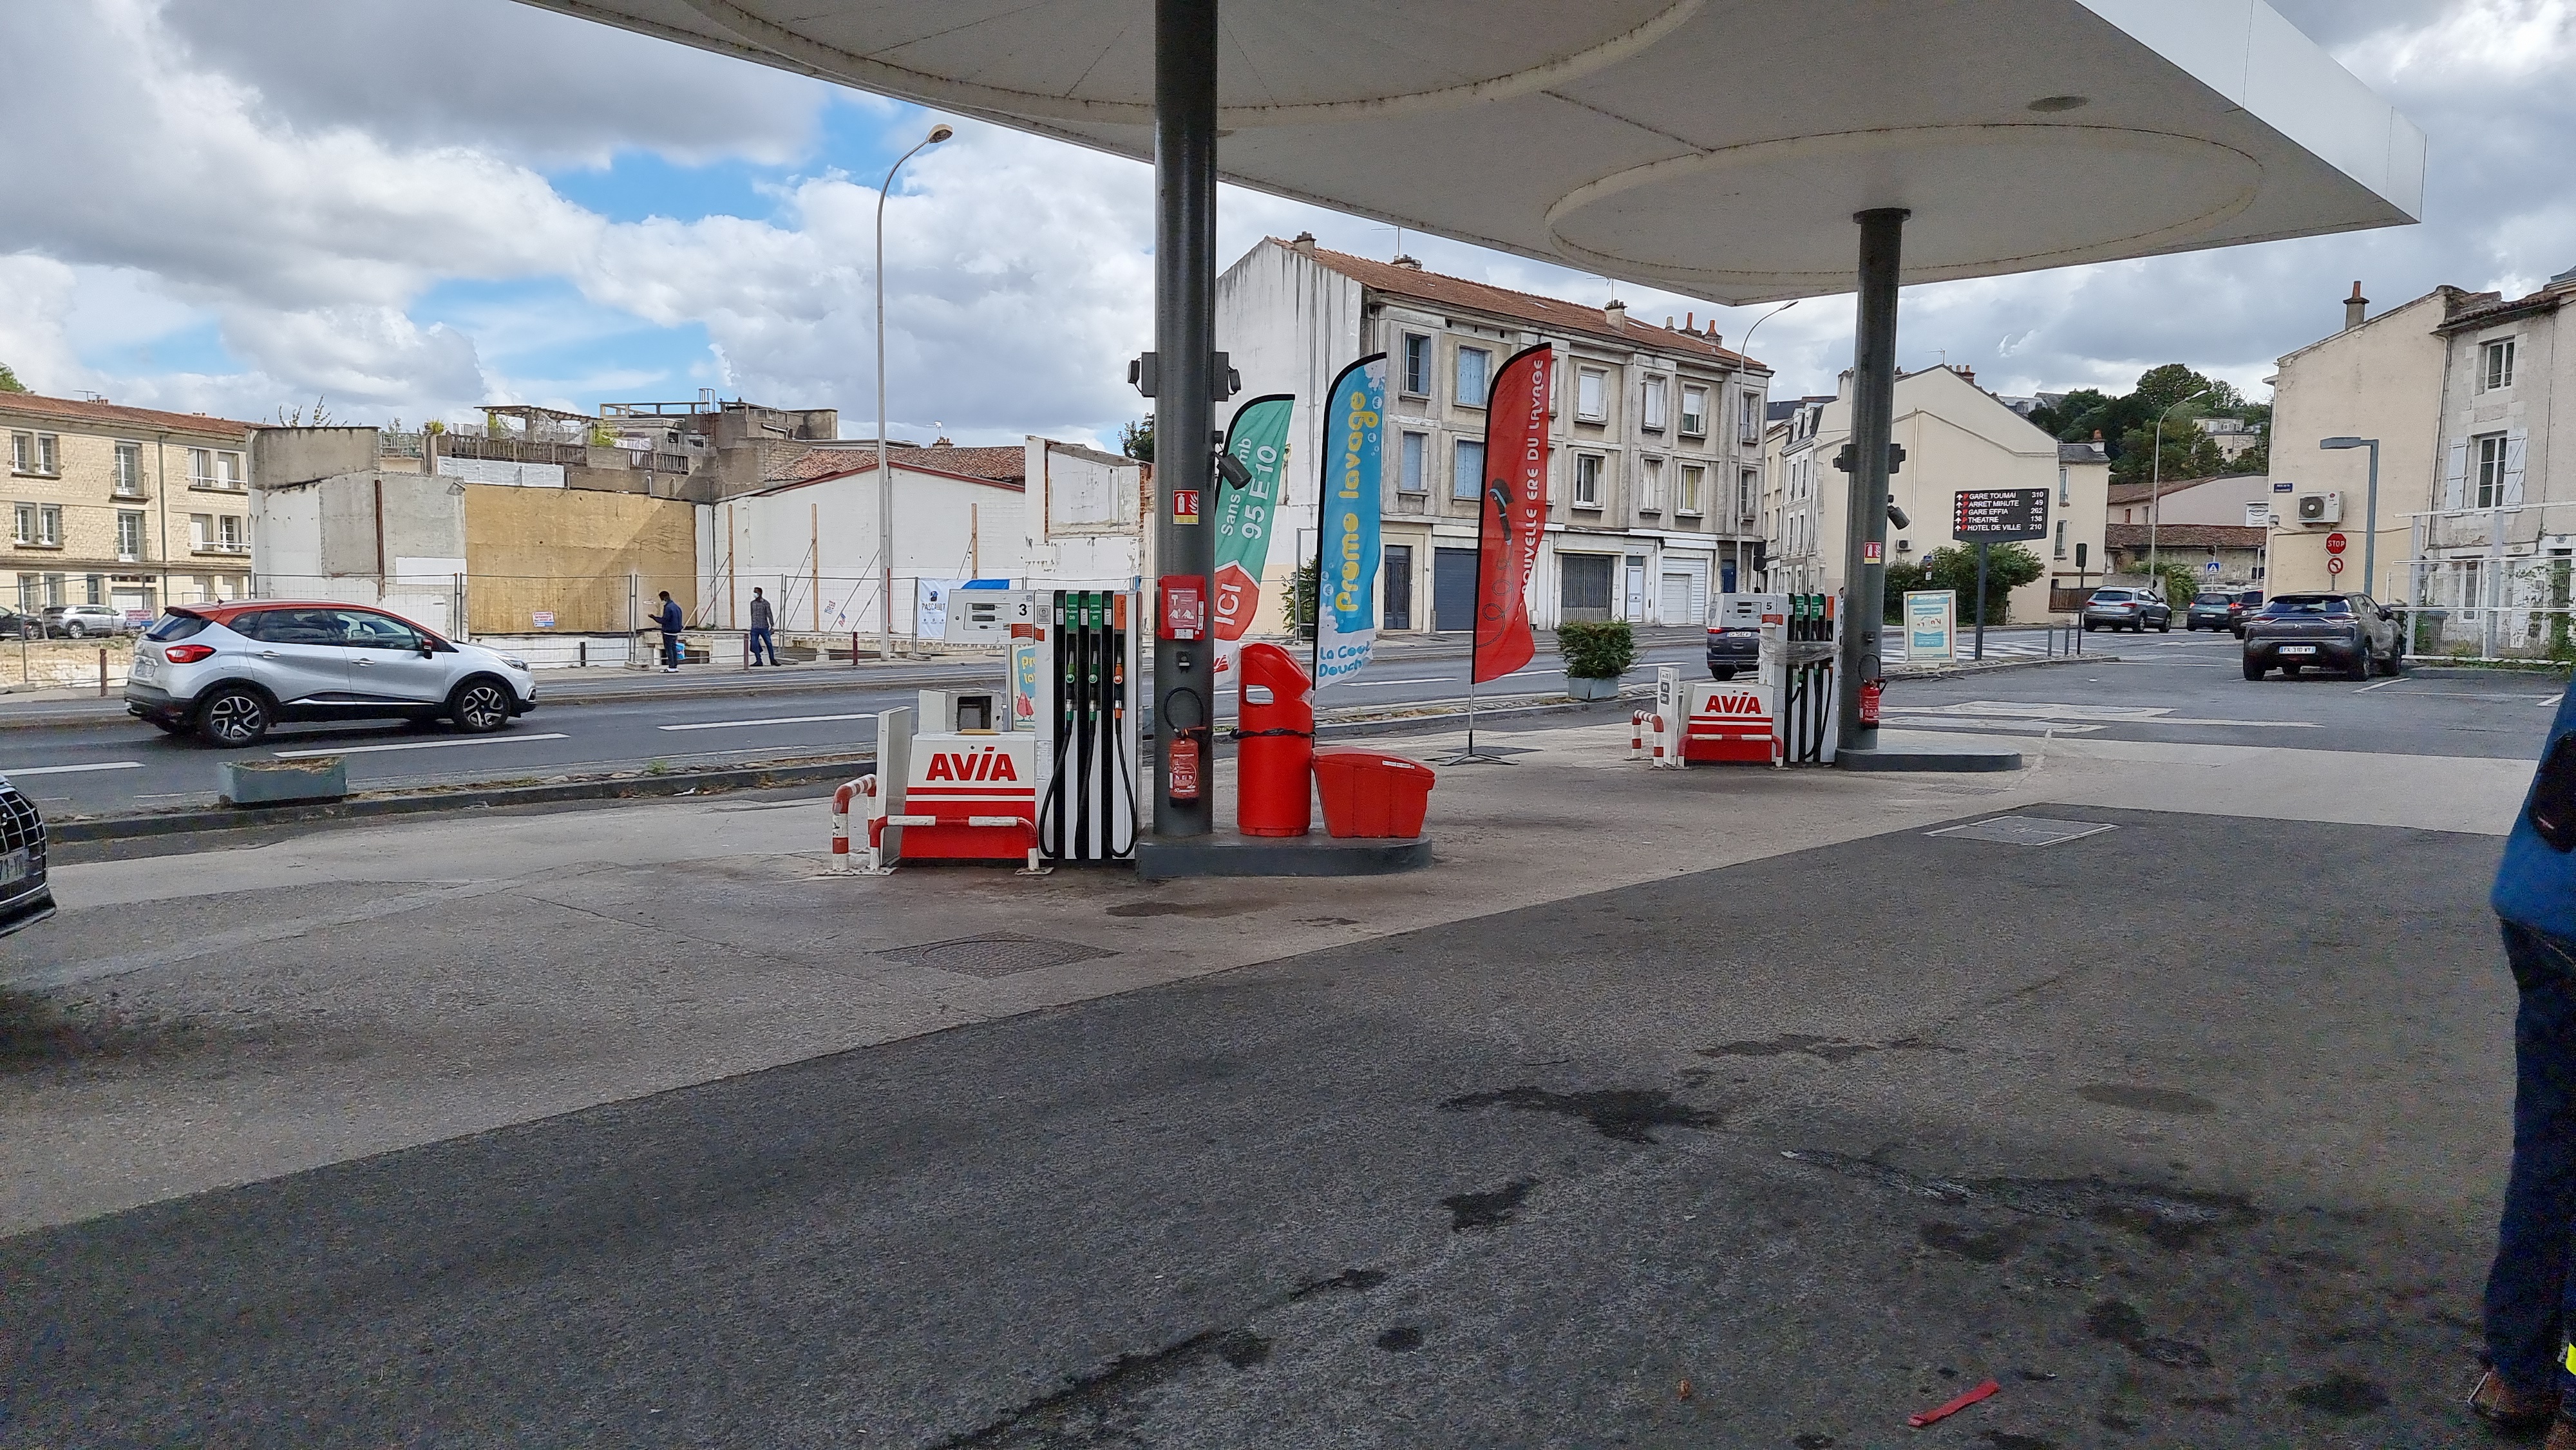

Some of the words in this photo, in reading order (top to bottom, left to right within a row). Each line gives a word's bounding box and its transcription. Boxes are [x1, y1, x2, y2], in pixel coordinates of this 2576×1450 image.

[1528, 359, 1544, 429] LAVAGE
[1527, 437, 1539, 461] DU
[1220, 493, 1241, 537] Sans
[1242, 504, 1265, 540] 95
[1018, 603, 1028, 616] 3
[1213, 582, 1242, 626] ICI
[1766, 602, 1772, 610] 5
[1338, 640, 1370, 659] Cool
[1704, 692, 1762, 715] AVIA
[925, 746, 1018, 782] AVIA
